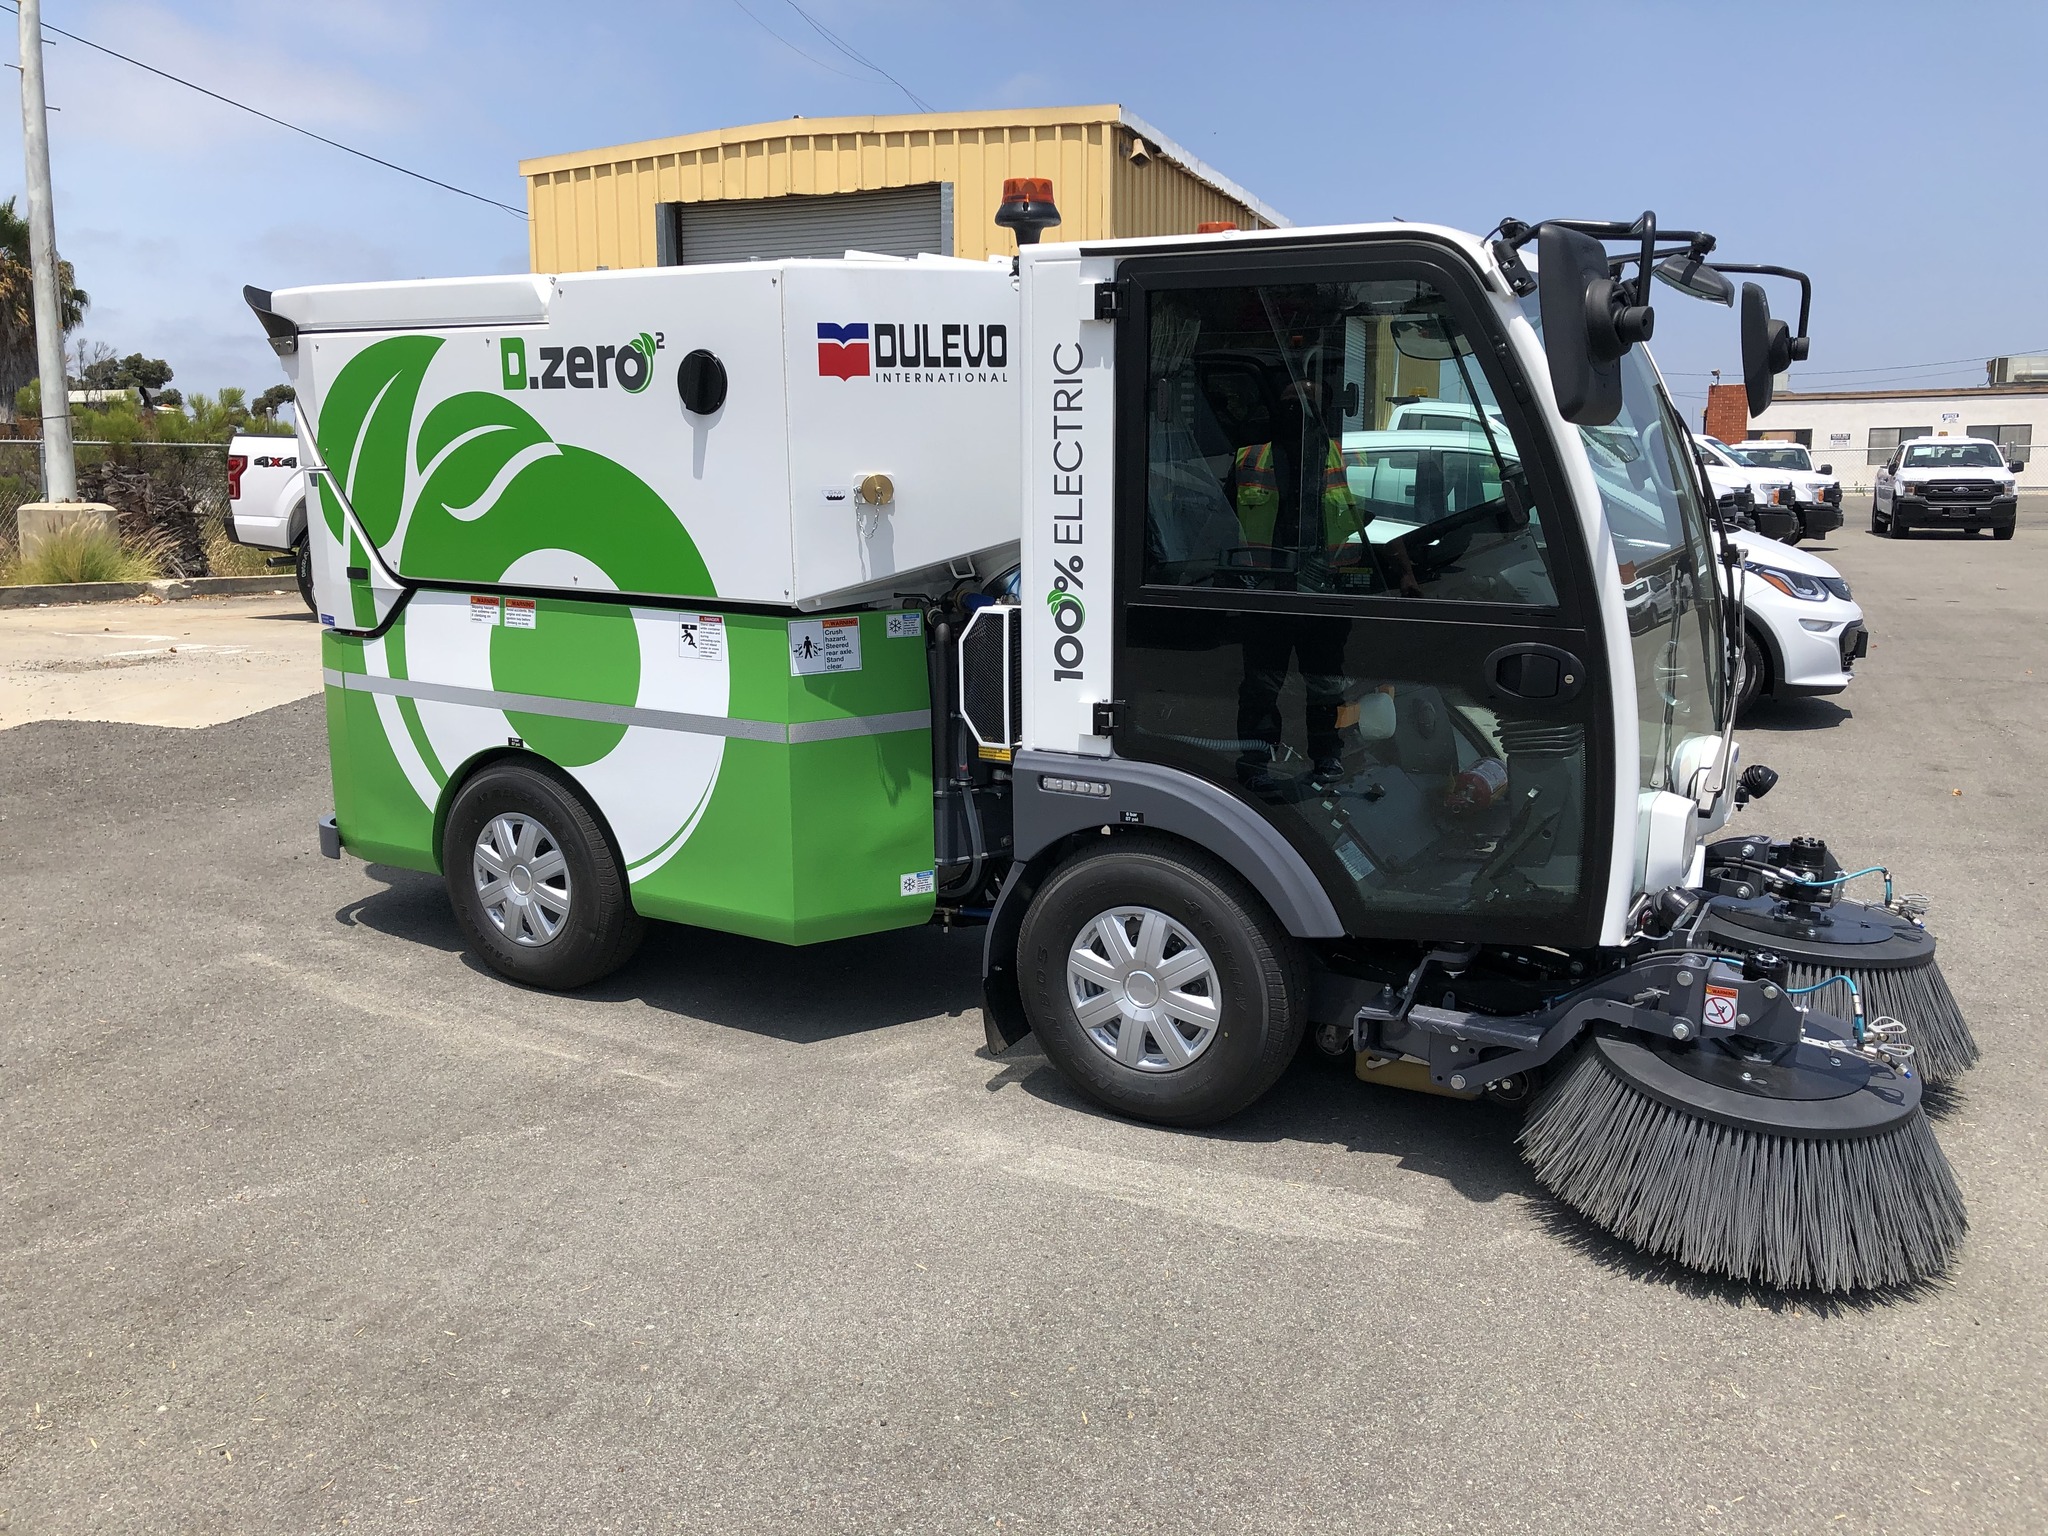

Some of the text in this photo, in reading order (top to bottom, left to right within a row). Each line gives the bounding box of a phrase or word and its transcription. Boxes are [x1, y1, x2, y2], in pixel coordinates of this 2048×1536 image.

[874, 323, 1007, 368] DULEVO
[875, 372, 1008, 383] INTERNATIONAL
[1053, 342, 1085, 682] 100% ELECTRIC
[825, 635, 848, 643] hazard.
